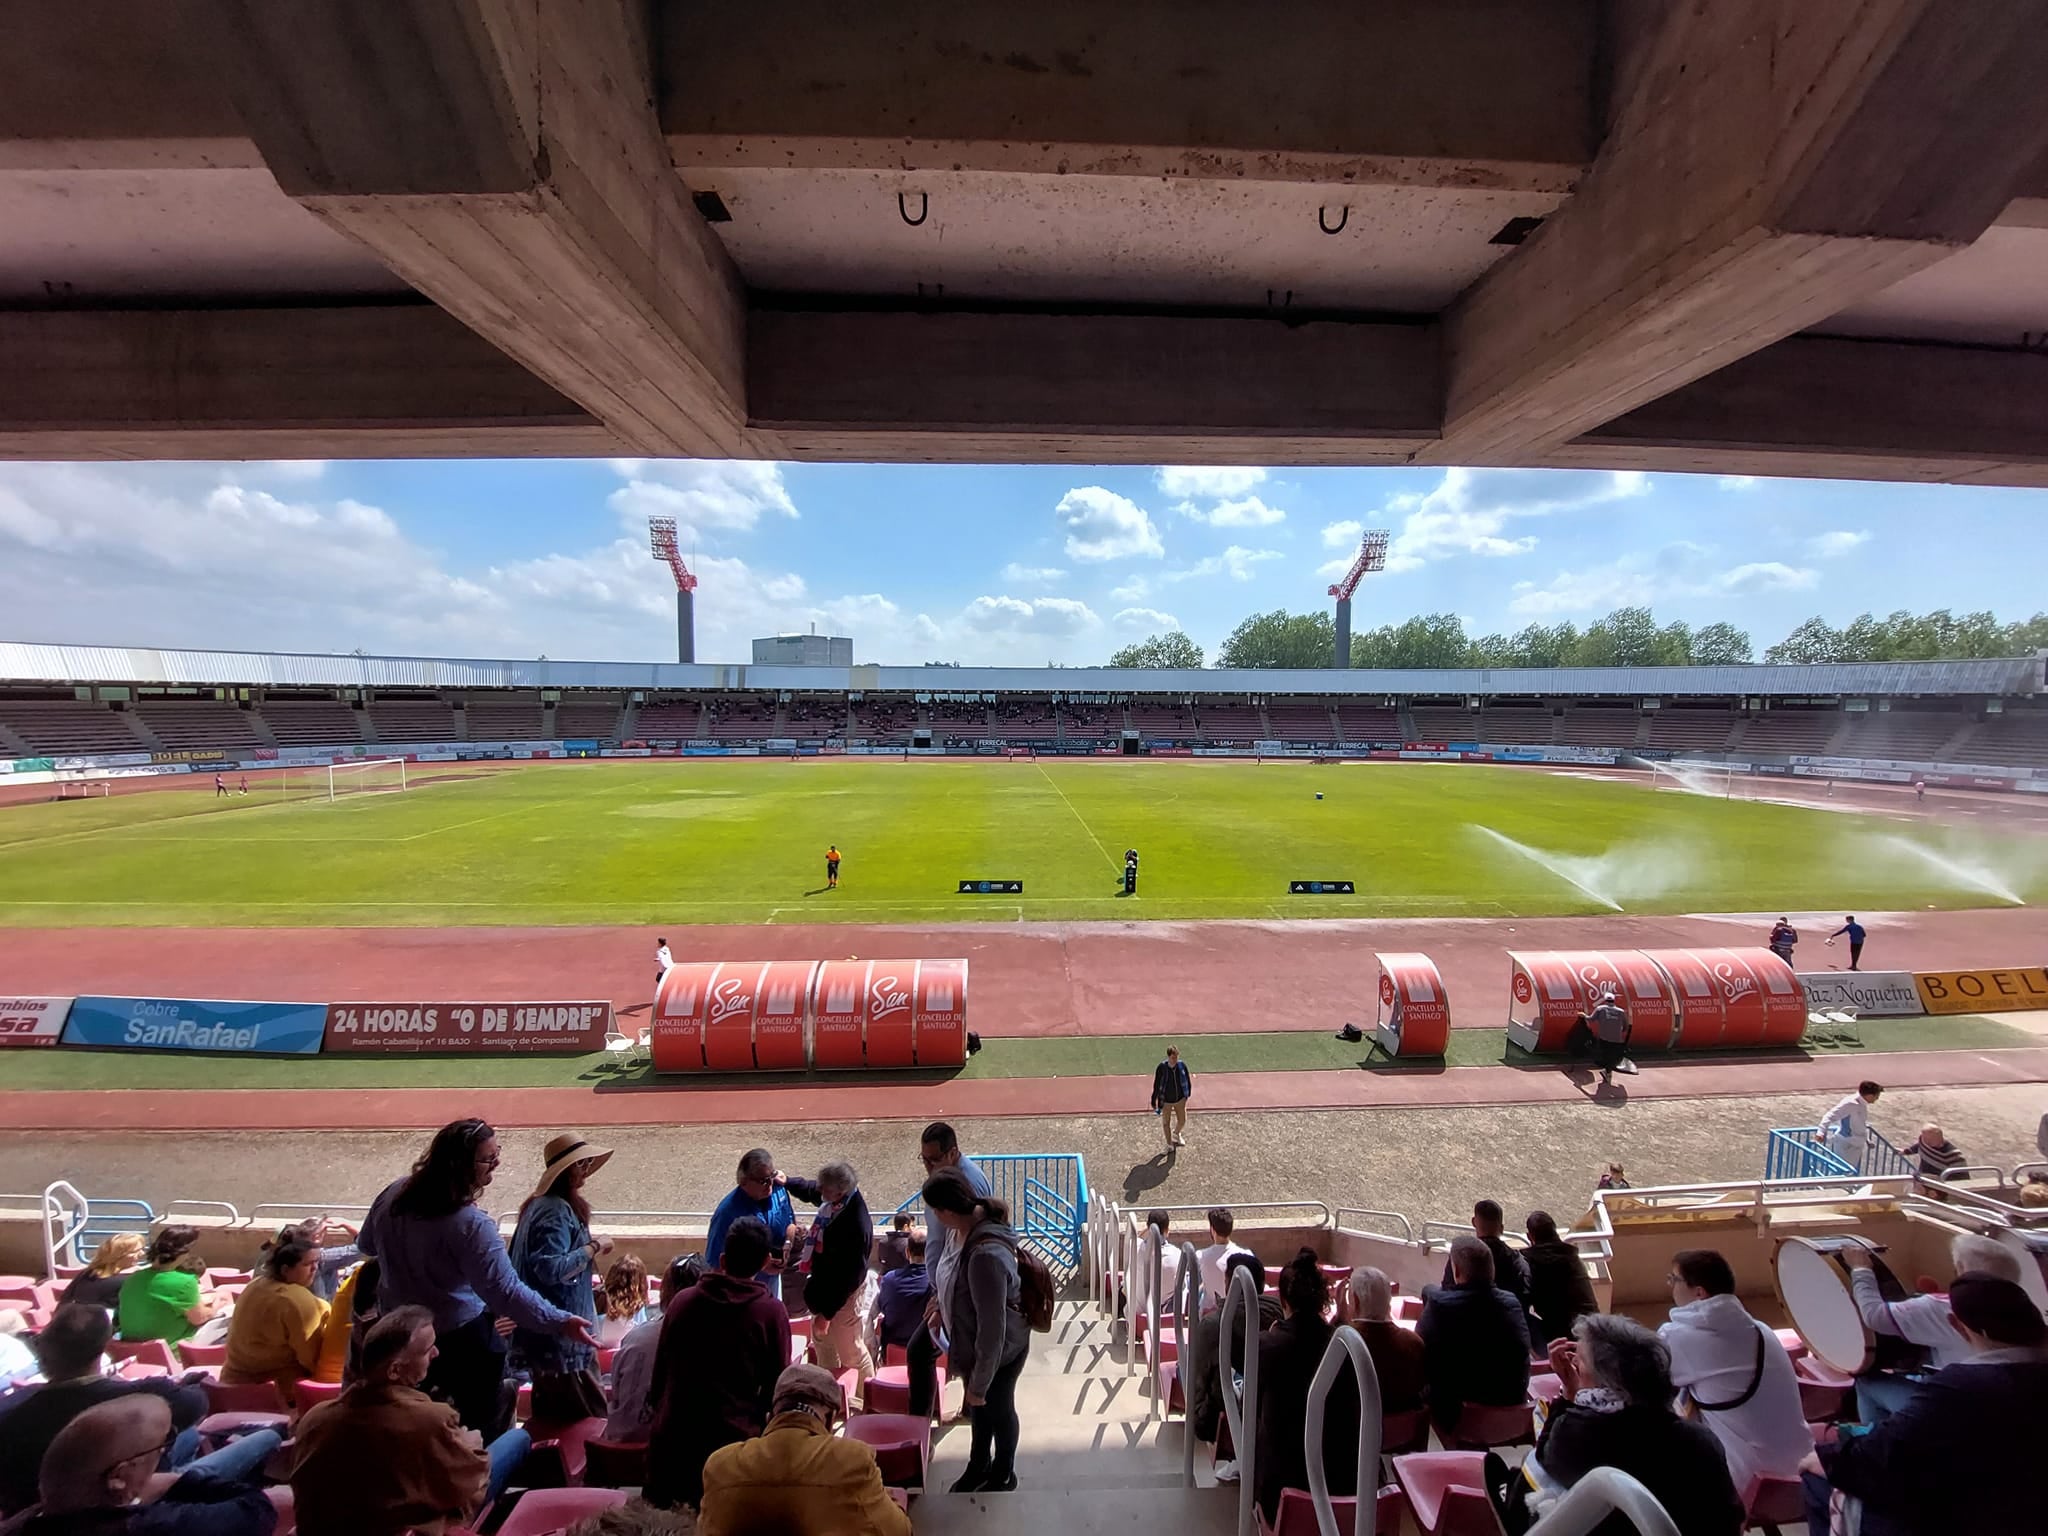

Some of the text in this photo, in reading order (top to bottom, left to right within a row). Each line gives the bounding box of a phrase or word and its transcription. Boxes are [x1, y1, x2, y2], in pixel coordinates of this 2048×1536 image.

[1338, 742, 1369, 750] FERRECAL
[1714, 963, 1752, 997] San
[1922, 973, 2047, 999] BOEL
[711, 978, 750, 1017] San
[871, 975, 909, 1014] San
[1835, 982, 1915, 1009] Nogueira
[133, 1001, 180, 1016] Cobre
[1403, 1004, 1435, 1012] CONCELLO
[334, 1009, 359, 1032] 24
[363, 1009, 438, 1032] HORAS
[481, 1008, 508, 1033] DE
[756, 1016, 791, 1025] CONCELLO
[817, 1015, 851, 1024] CONCELLO
[917, 1013, 951, 1022] CONCELLO
[1409, 1012, 1441, 1020] SANTIAGO
[654, 1018, 690, 1027] CONCELLO
[922, 1022, 957, 1030] SANTIAGO
[762, 1025, 797, 1033] SANTIAGO
[822, 1024, 857, 1032] SANTIAGO
[124, 1018, 260, 1049] SanRafael
[352, 1037, 381, 1045] Ramón
[482, 1037, 518, 1047] Santiago
[519, 1037, 531, 1045] de
[532, 1037, 580, 1047] Compostela
